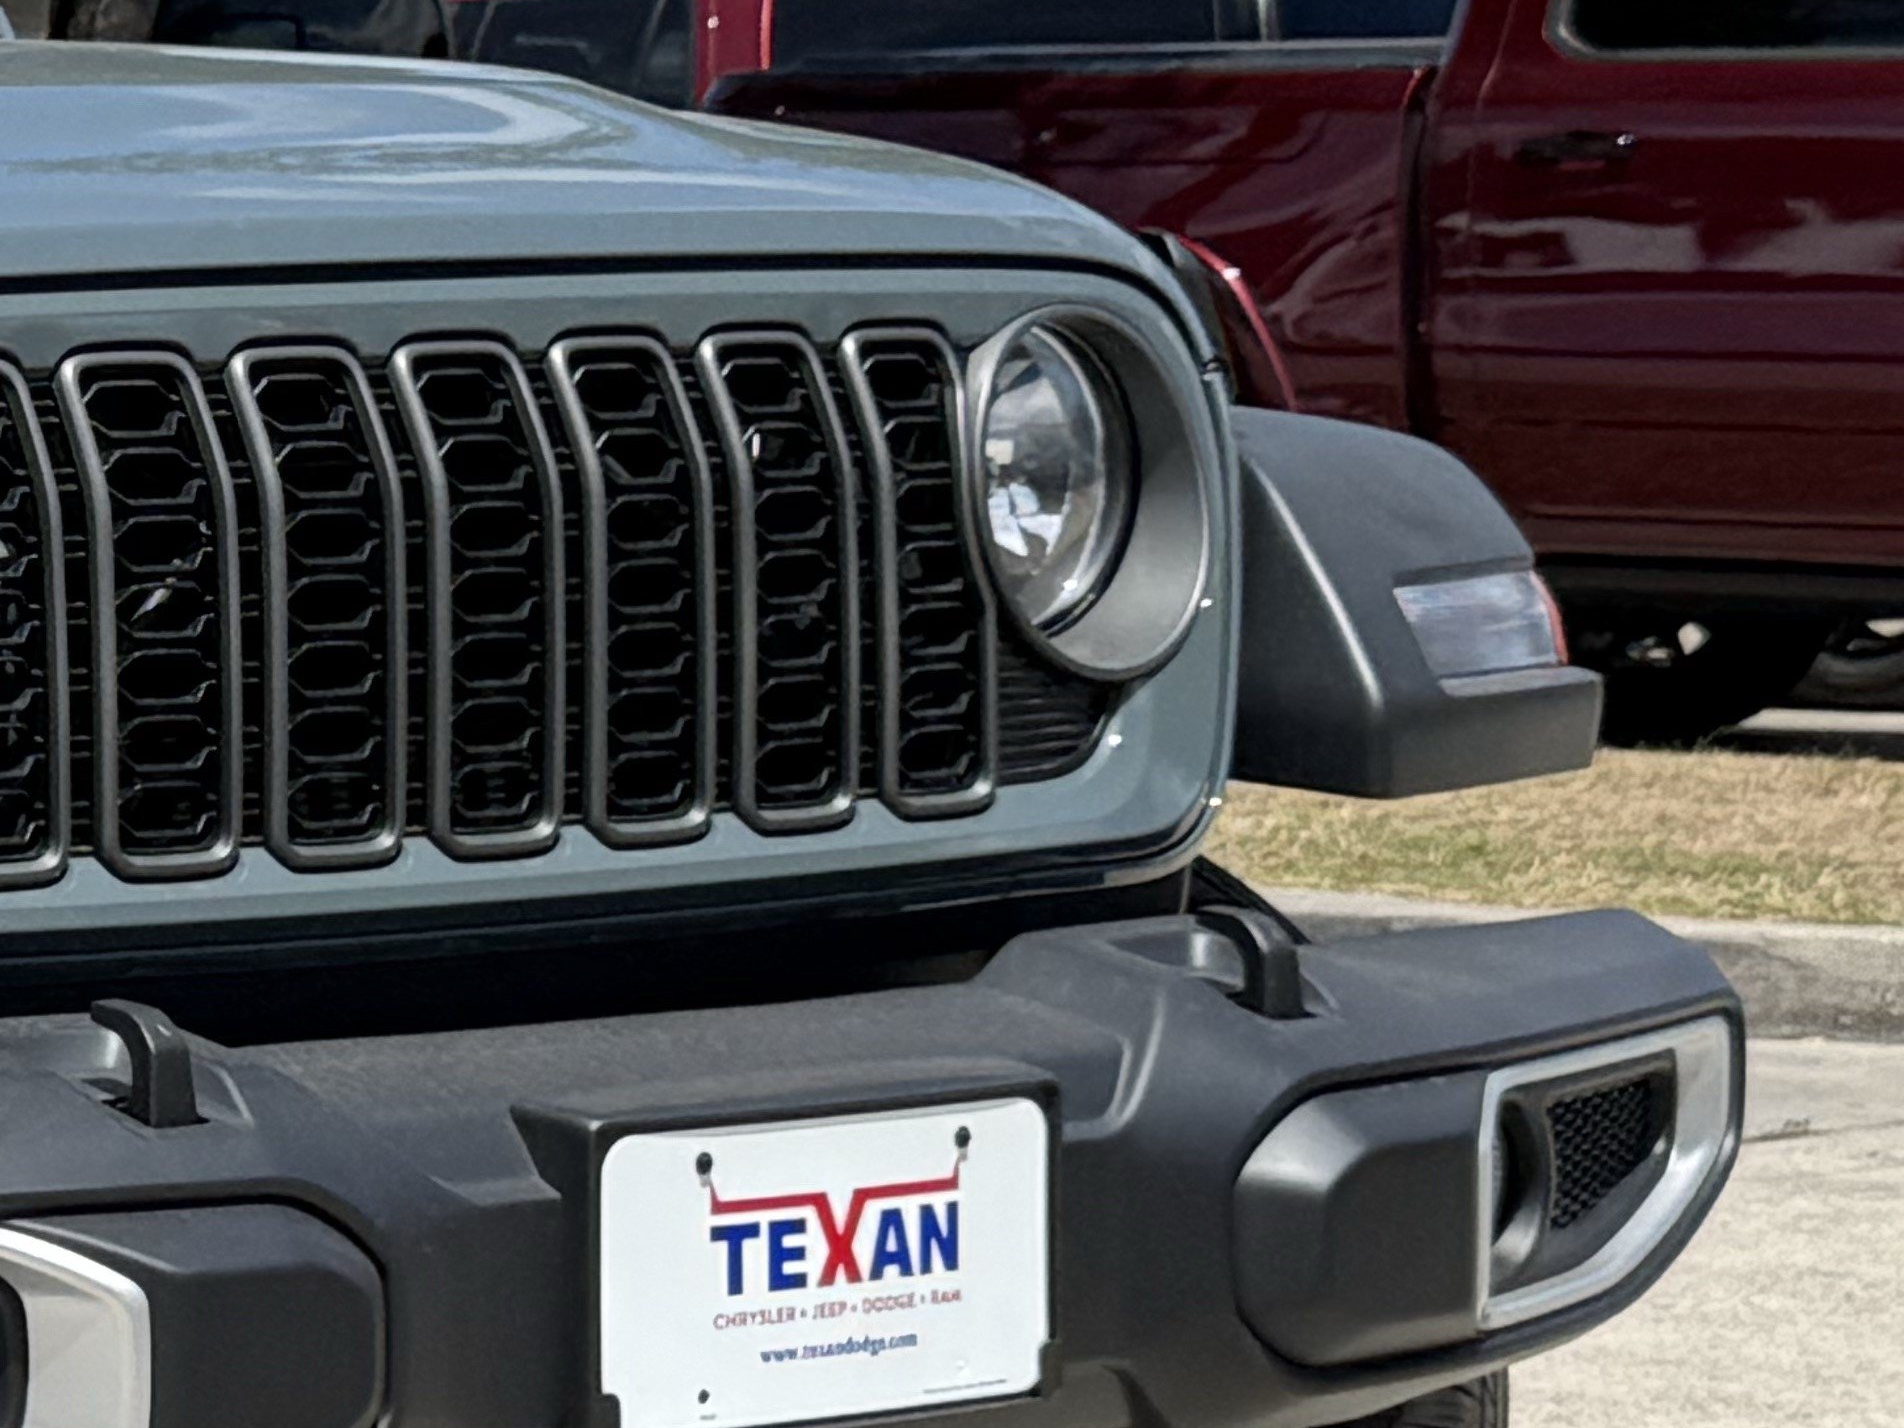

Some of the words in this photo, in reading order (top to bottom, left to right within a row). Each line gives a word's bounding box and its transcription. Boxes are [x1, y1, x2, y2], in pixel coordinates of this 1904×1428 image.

[709, 1172, 960, 1296] TEXAN
[712, 1305, 796, 1330] CHRYSLER
[812, 1300, 848, 1320] JEEP
[861, 1291, 917, 1315] DODGE
